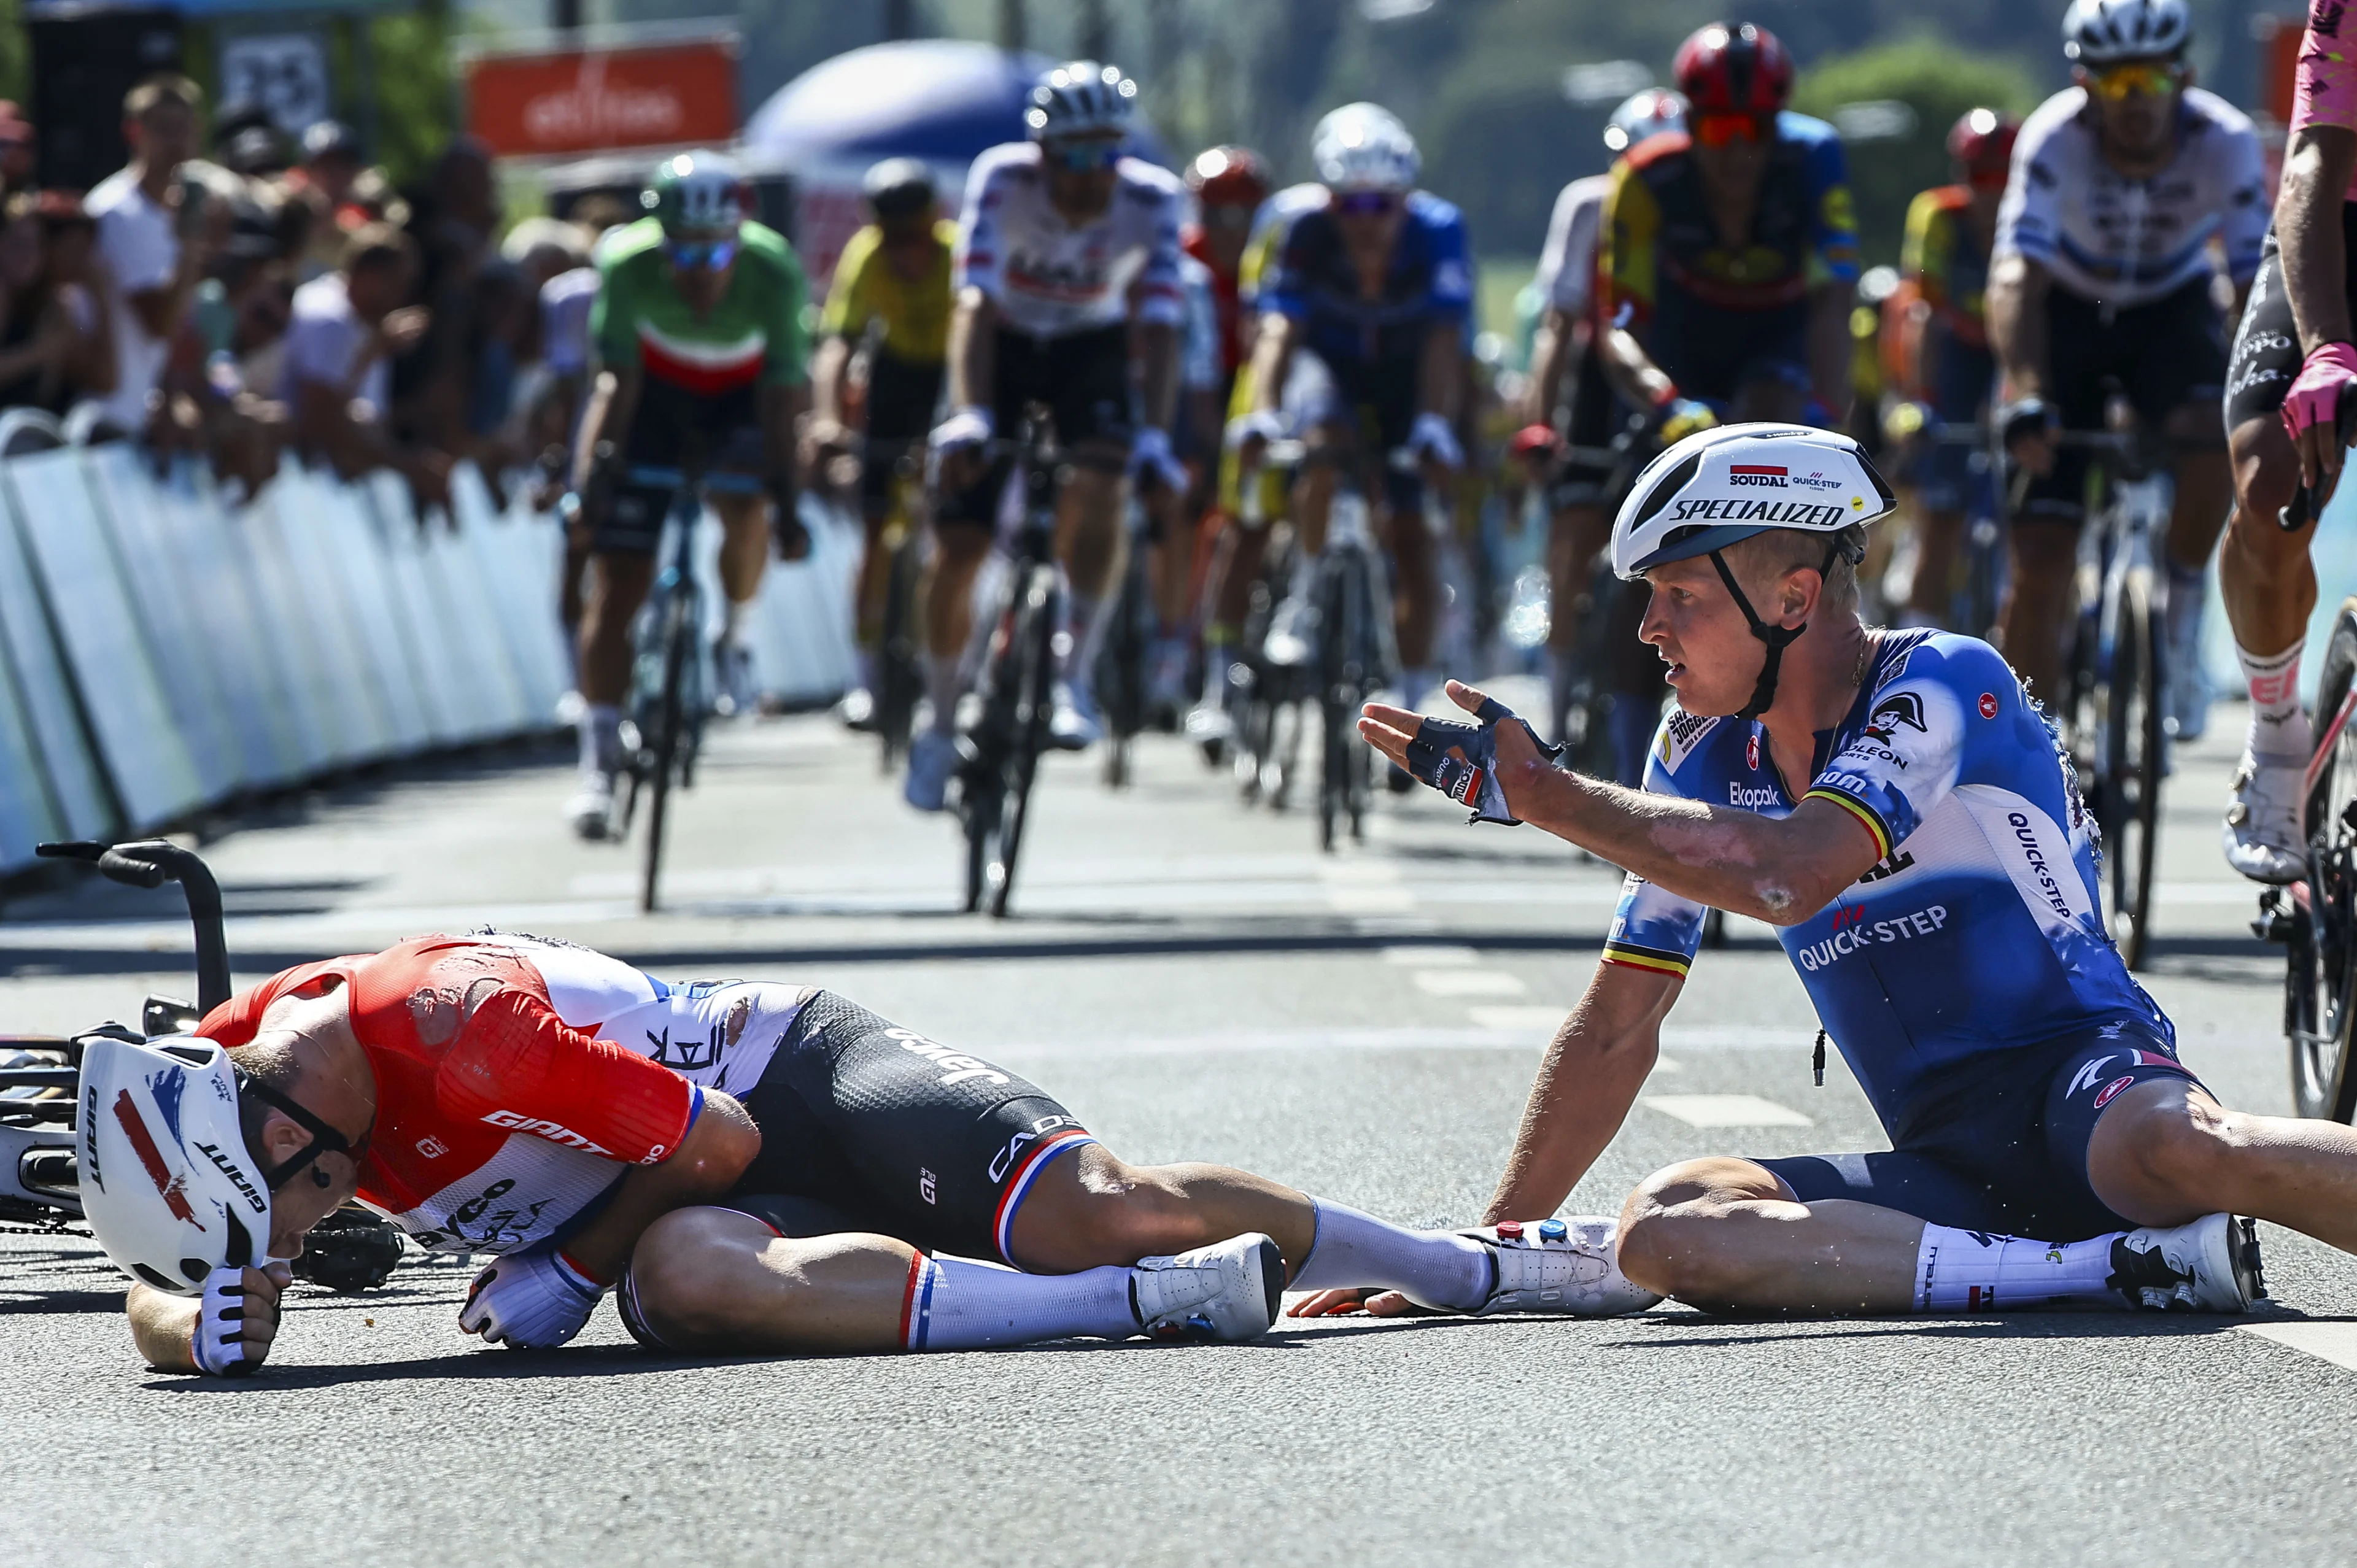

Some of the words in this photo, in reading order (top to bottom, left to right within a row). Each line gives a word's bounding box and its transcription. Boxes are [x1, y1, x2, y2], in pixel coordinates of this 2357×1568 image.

[1730, 475, 1789, 488] SOUDAL
[1668, 500, 1844, 526] SPECIALIZED
[1730, 781, 1780, 812] Ekopak
[87, 1084, 106, 1195] GIANT
[479, 1110, 615, 1155] GIANT
[193, 1141, 268, 1214] GIANT
